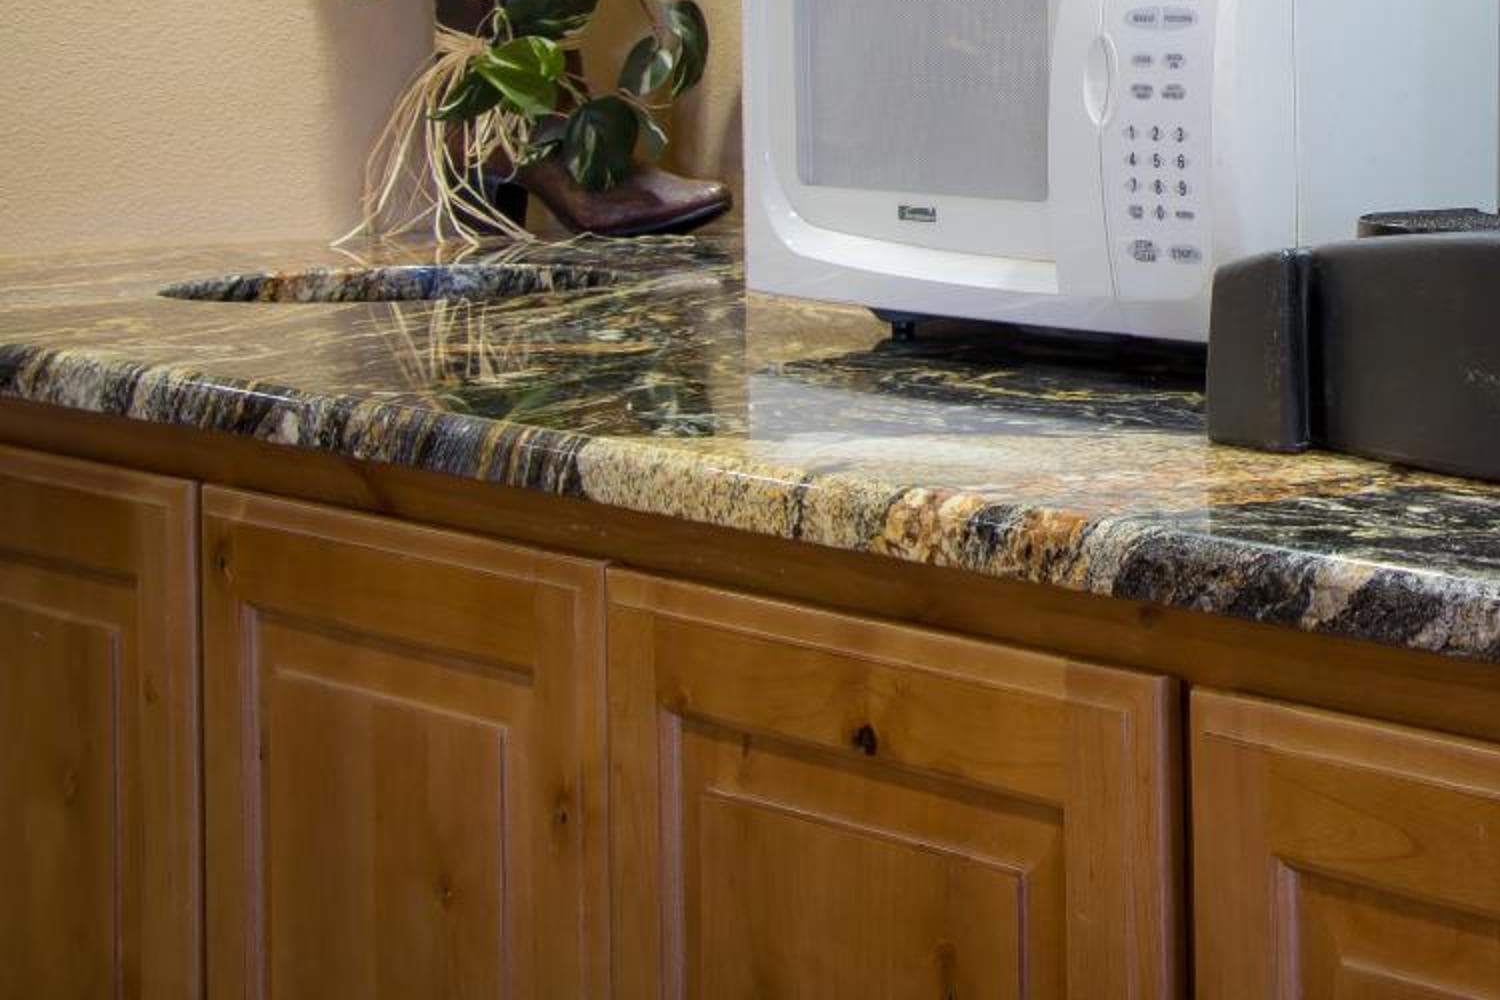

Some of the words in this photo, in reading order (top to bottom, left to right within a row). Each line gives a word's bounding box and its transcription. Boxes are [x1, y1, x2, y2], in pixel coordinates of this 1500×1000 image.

[1129, 125, 1135, 140] 1
[1152, 125, 1159, 141] 2
[1176, 127, 1184, 143] 3
[1129, 152, 1136, 167] 4
[1152, 153, 1161, 168] 5
[1176, 154, 1185, 170] 6
[1129, 177, 1137, 194] 7
[1154, 179, 1163, 195] 8
[1178, 180, 1187, 196] 9
